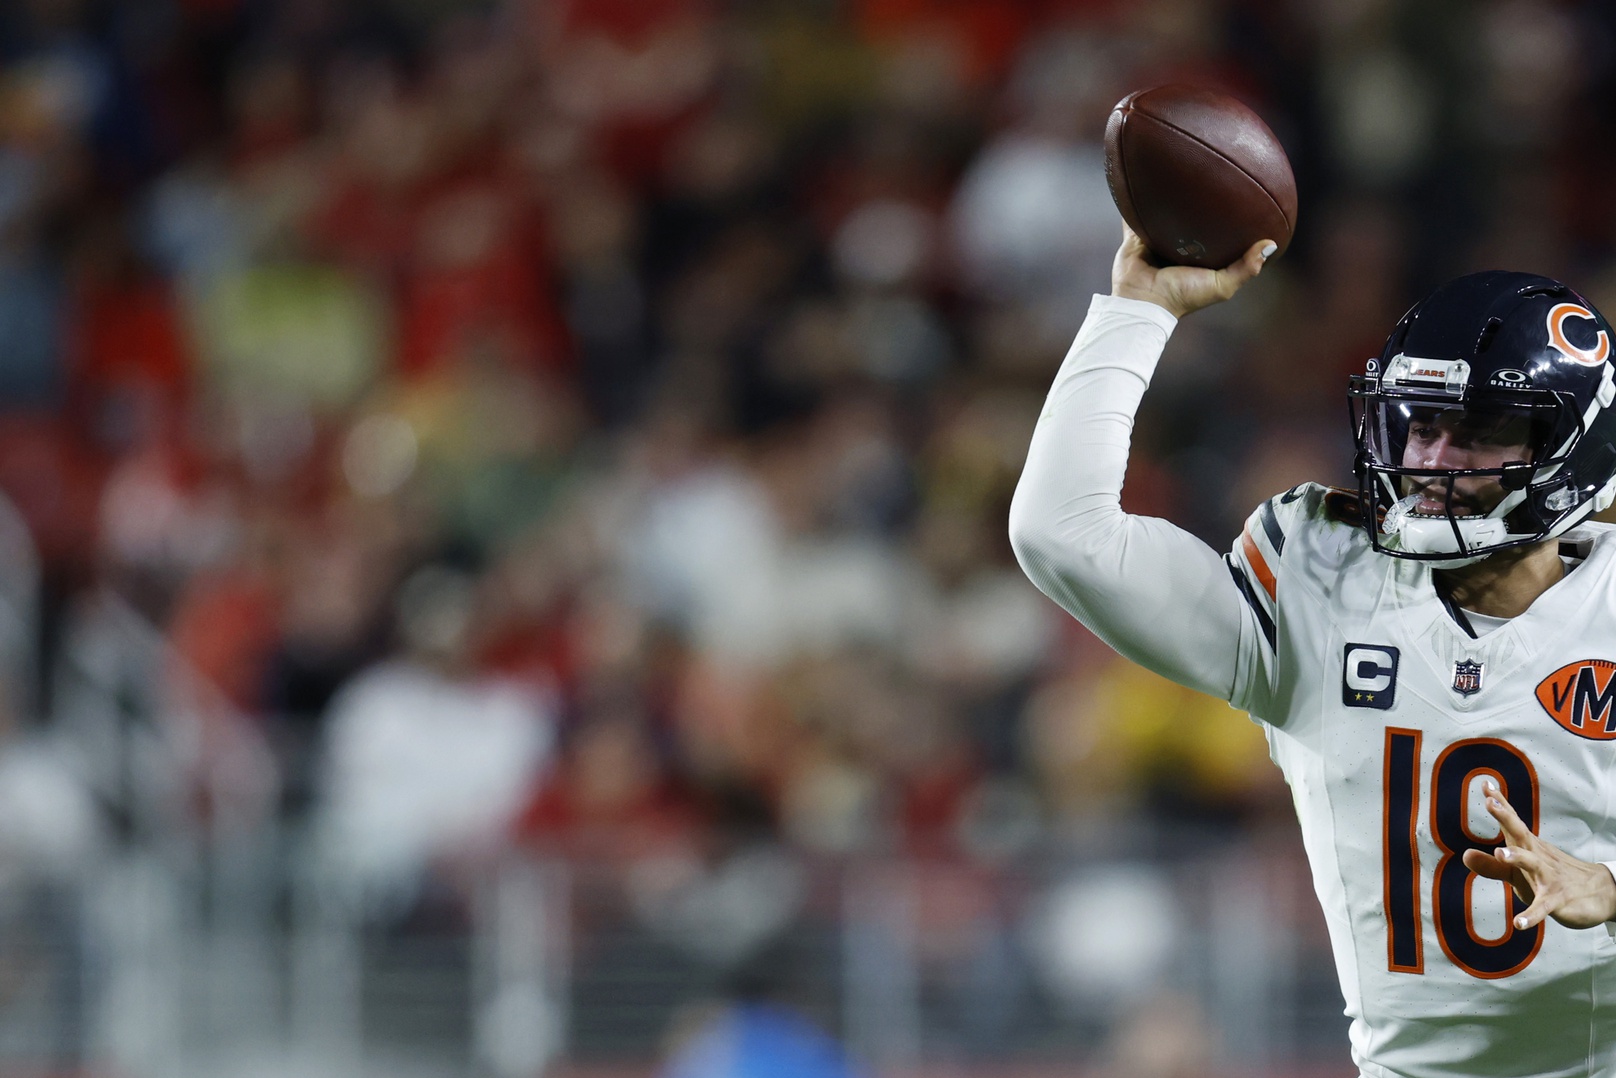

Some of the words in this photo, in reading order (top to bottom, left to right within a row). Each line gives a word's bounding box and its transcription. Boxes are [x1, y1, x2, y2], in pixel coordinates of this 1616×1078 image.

[1546, 303, 1610, 367] C
[1411, 369, 1446, 378] EARS
[1490, 379, 1532, 389] OAKLEY
[1346, 648, 1393, 692] C
[1456, 674, 1480, 690] NFL
[1383, 726, 1545, 979] 18
